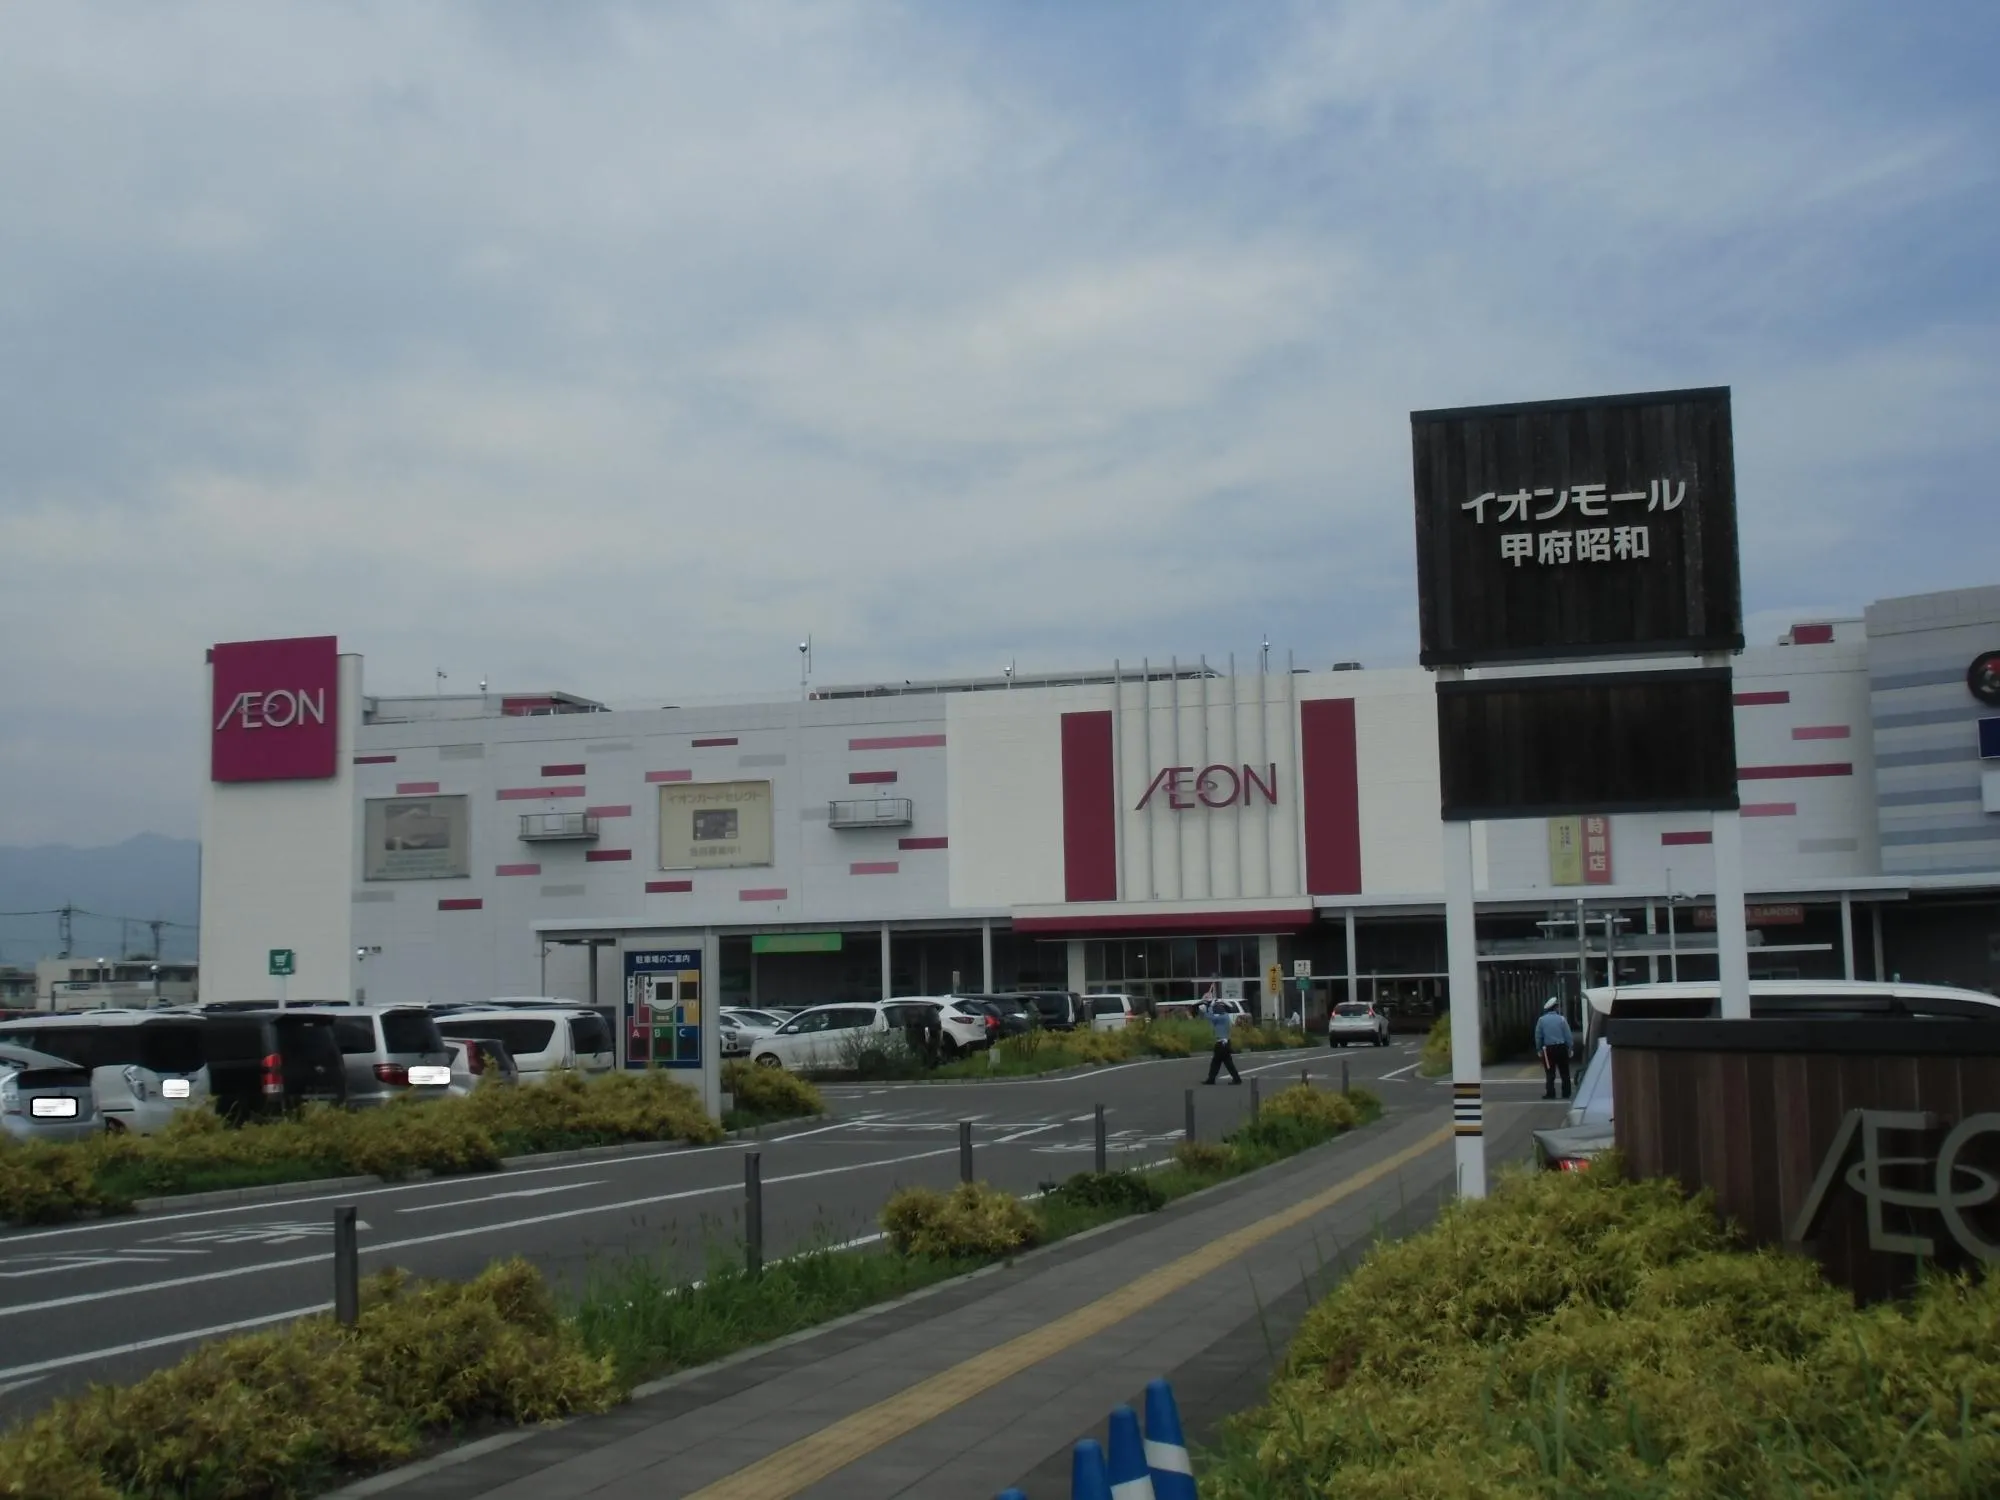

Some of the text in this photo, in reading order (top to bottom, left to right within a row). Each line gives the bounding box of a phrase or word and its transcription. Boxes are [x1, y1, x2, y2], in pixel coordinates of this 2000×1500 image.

[1461, 479, 1686, 524] イオンモール
[1500, 525, 1650, 567] 甲府昭和
[632, 1029, 640, 1038] A
[654, 1029, 661, 1038] B
[679, 1029, 686, 1038] C
